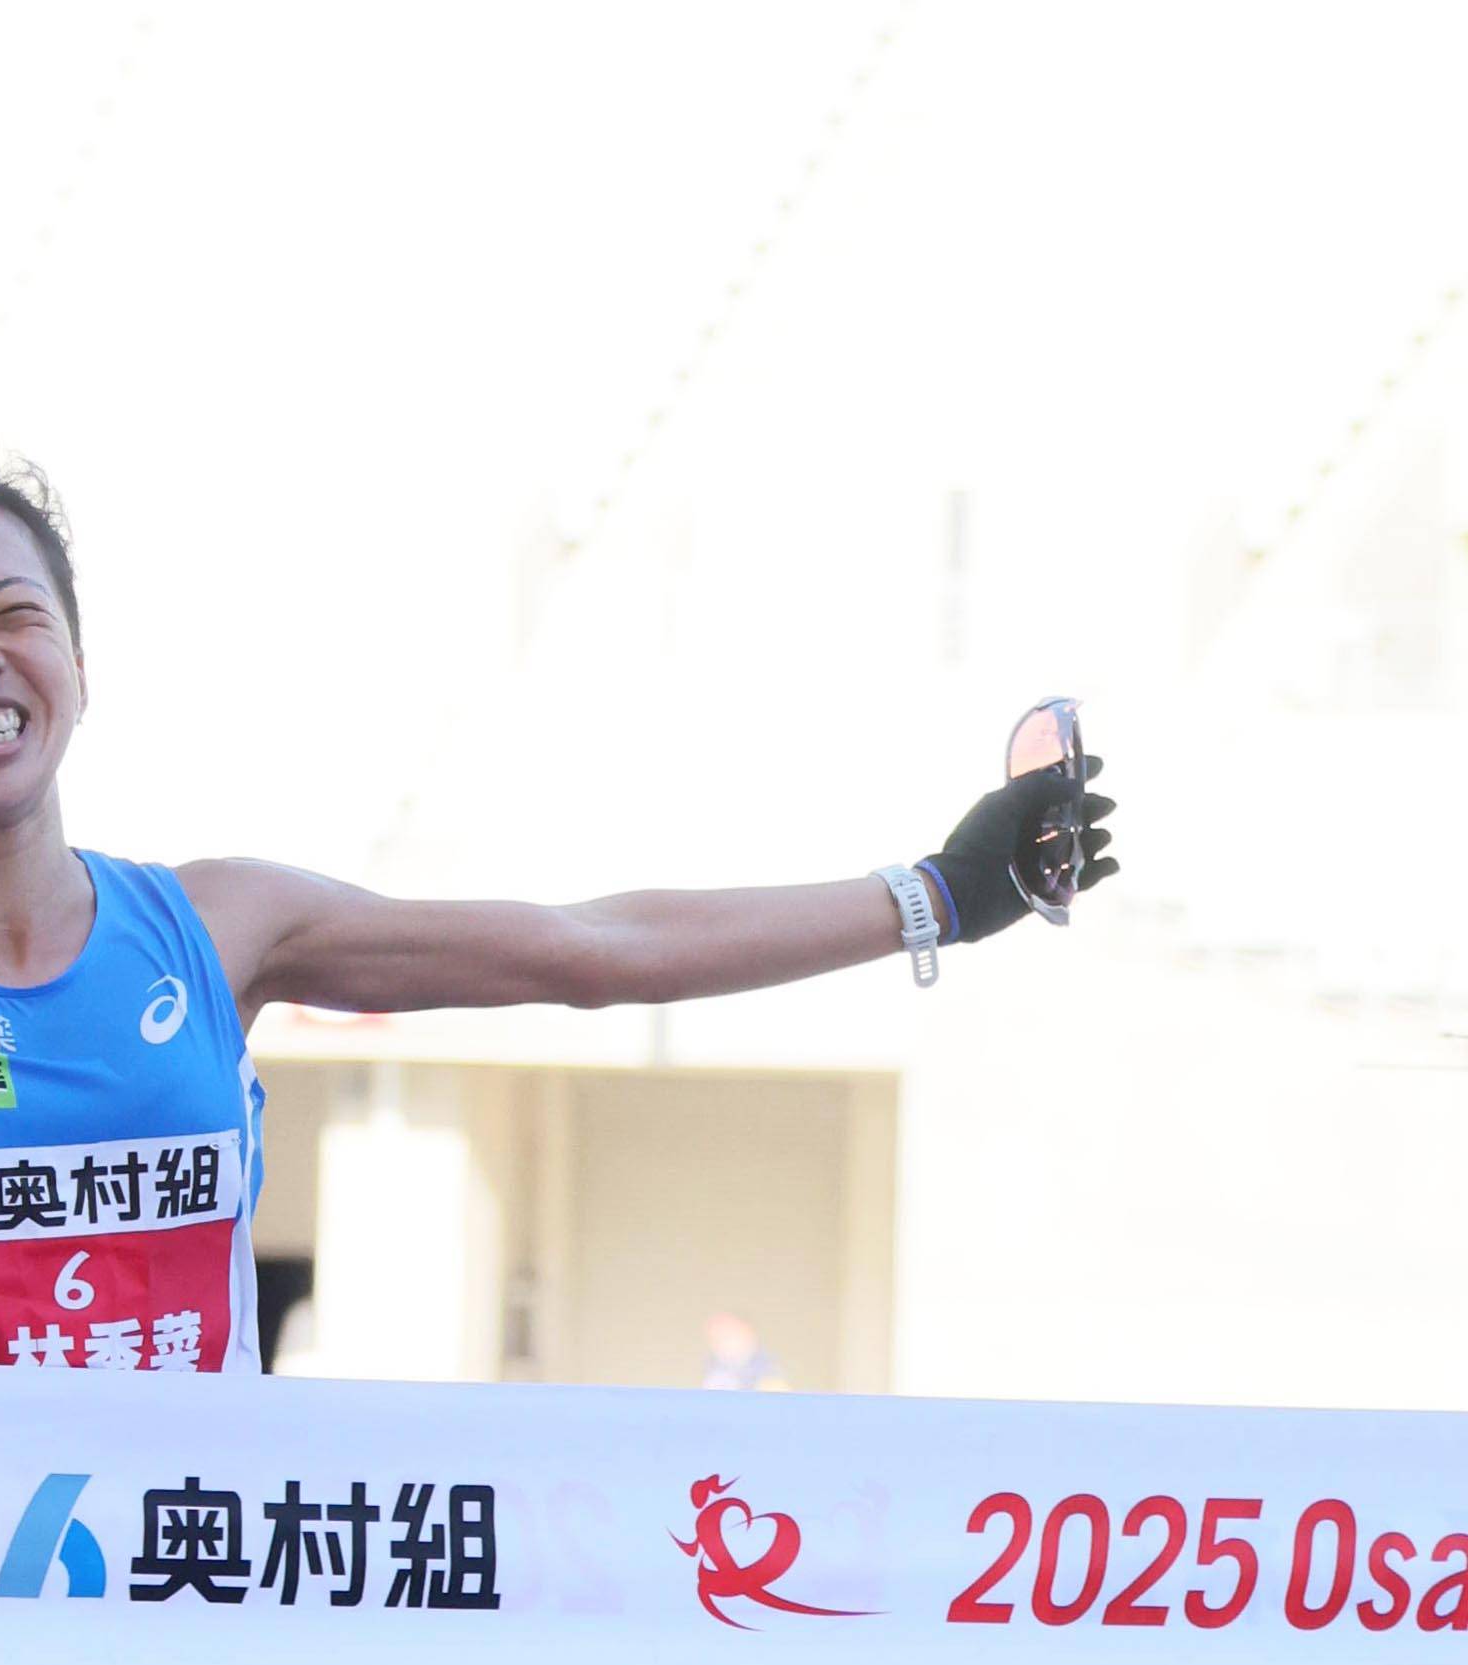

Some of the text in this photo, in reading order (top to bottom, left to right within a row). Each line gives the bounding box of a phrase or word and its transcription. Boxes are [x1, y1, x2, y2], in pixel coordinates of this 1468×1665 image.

[53, 1251, 95, 1311] 6
[129, 1476, 501, 1610] 奥村組
[946, 1491, 1264, 1630] 2025
